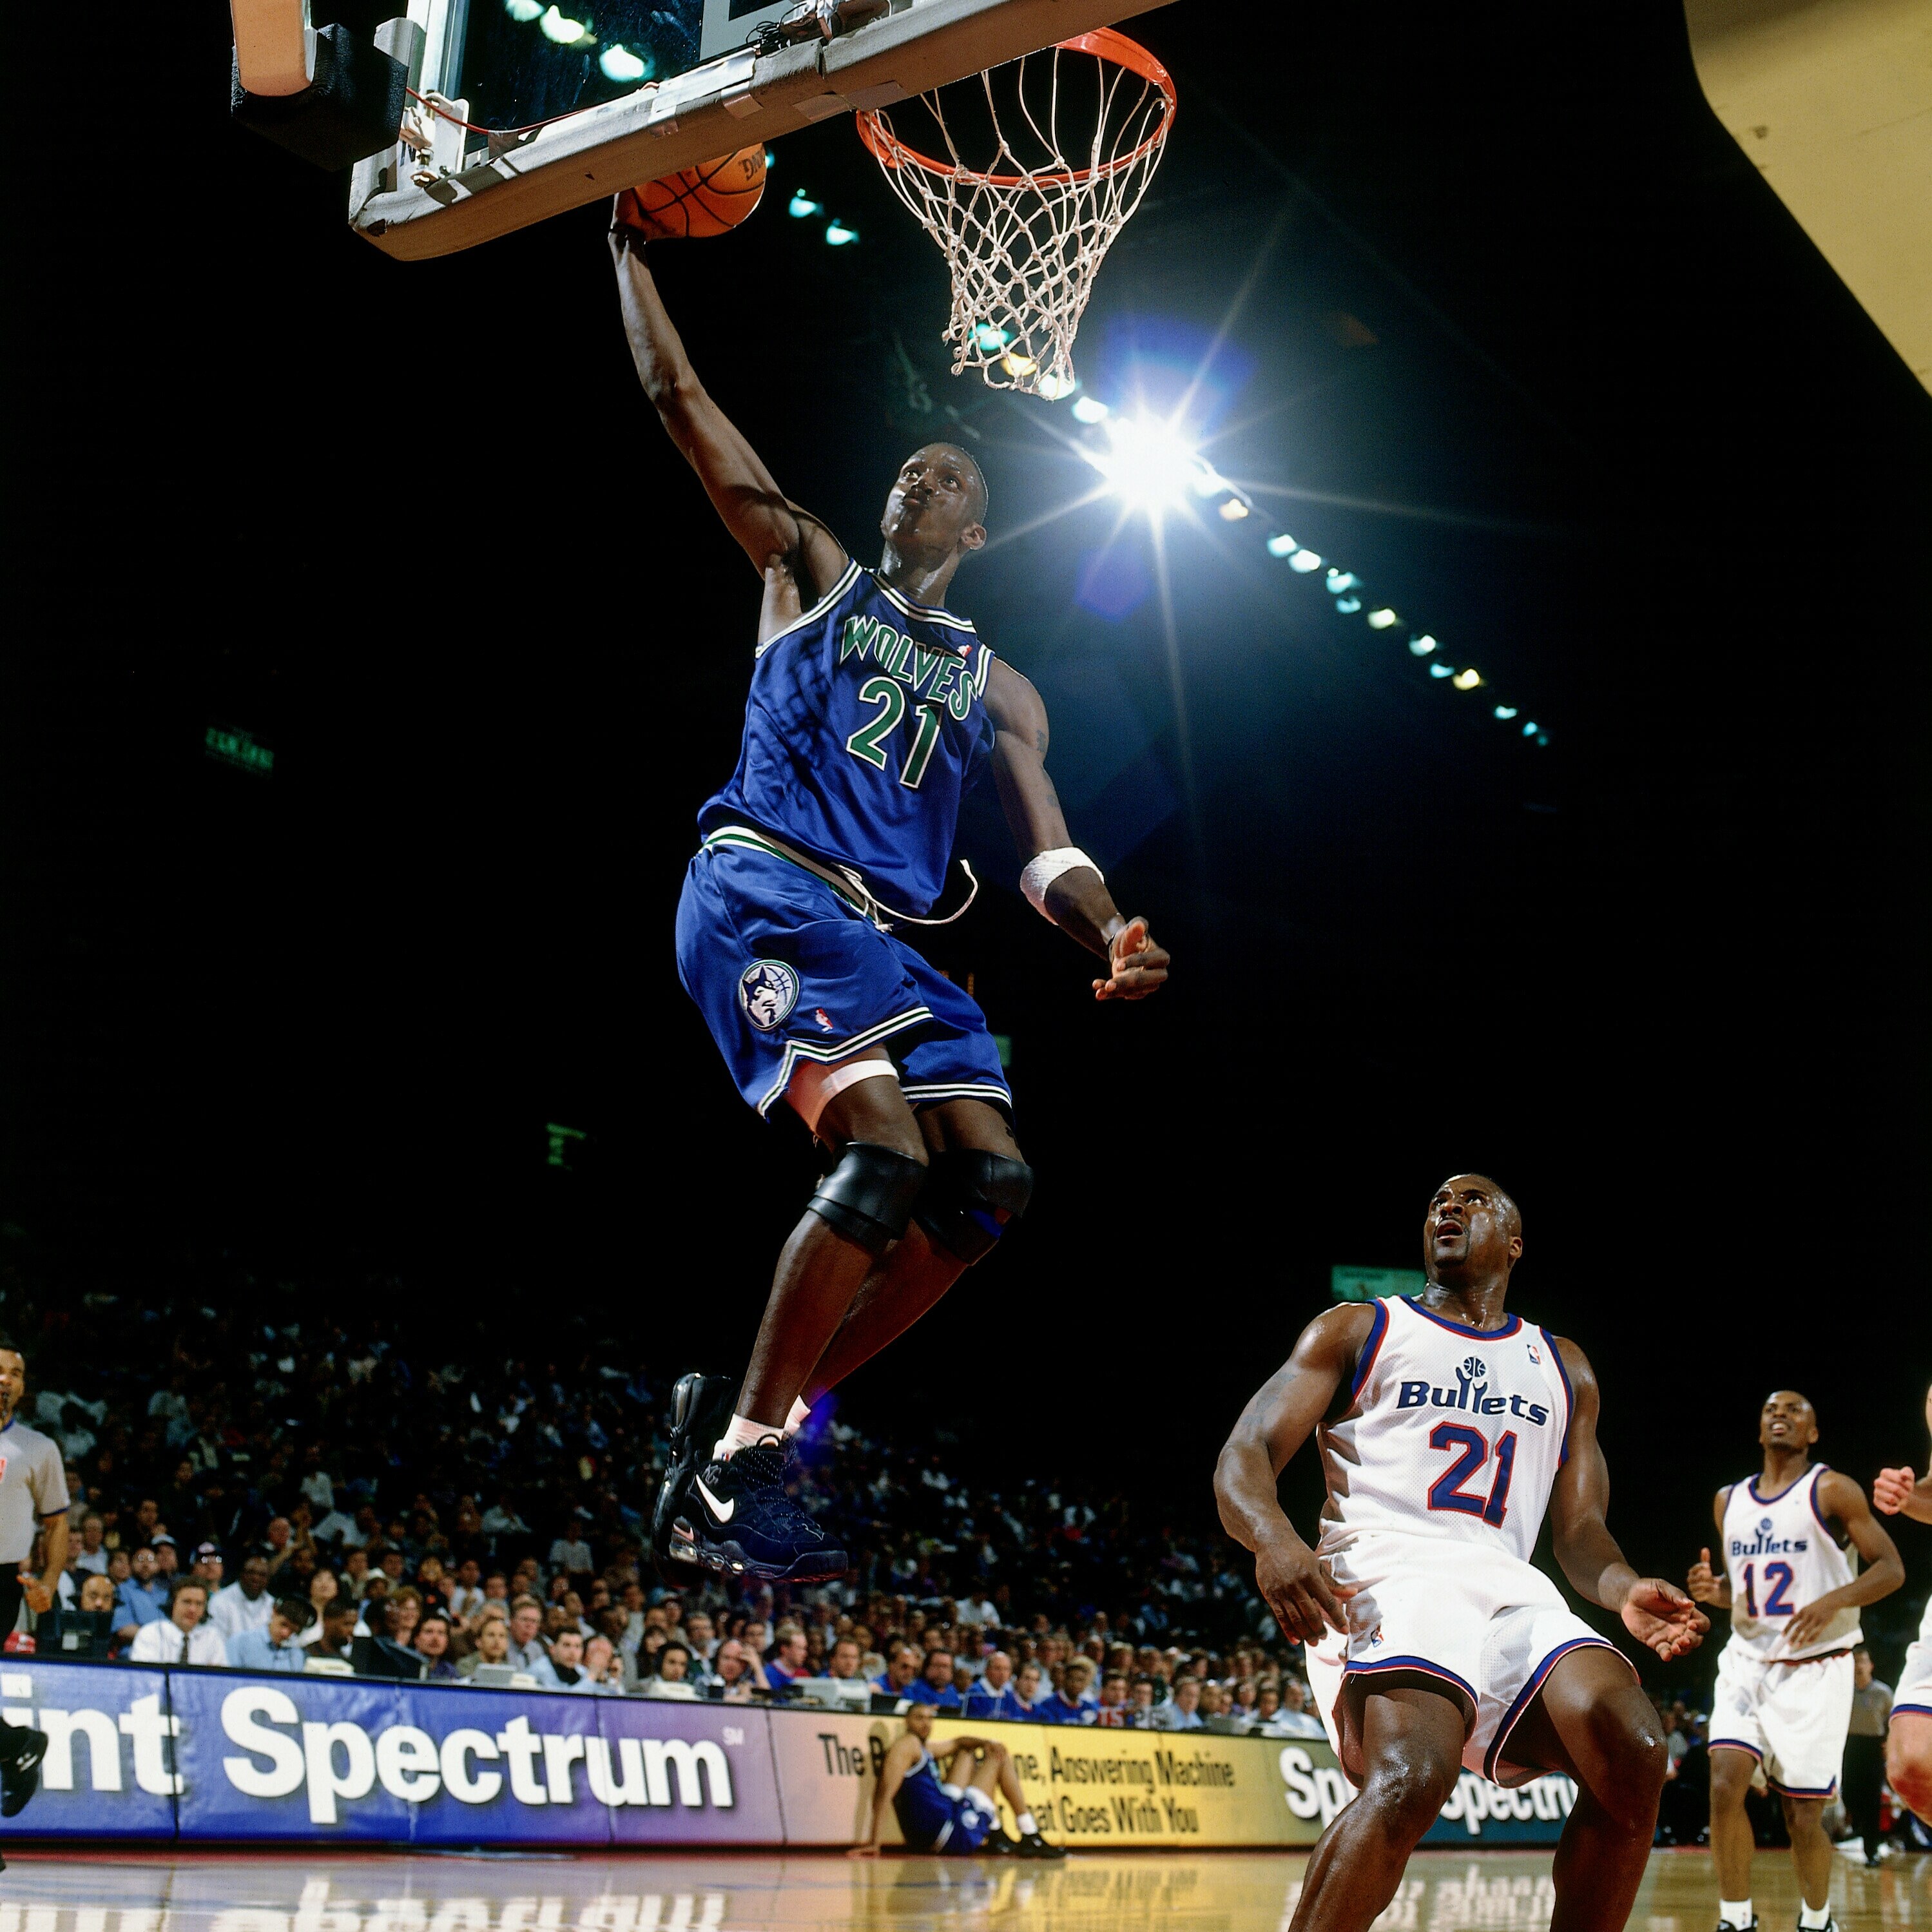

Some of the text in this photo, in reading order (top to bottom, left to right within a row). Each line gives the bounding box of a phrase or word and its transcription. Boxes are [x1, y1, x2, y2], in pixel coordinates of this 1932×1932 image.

[840, 614, 978, 721] WOLVES
[846, 676, 943, 789] 21
[1395, 1366, 1550, 1428] Bullets
[1427, 1420, 1518, 1529] 21
[1731, 1527, 1808, 1556] Bullets
[1743, 1561, 1795, 1618] 12
[220, 1686, 733, 1824] Spectrum
[817, 1732, 865, 1776] The
[1050, 1746, 1155, 1794] Answering
[1155, 1750, 1235, 1787] Machine
[1060, 1795, 1112, 1833] Goes
[1109, 1795, 1164, 1833] With
[1161, 1796, 1200, 1833] You
